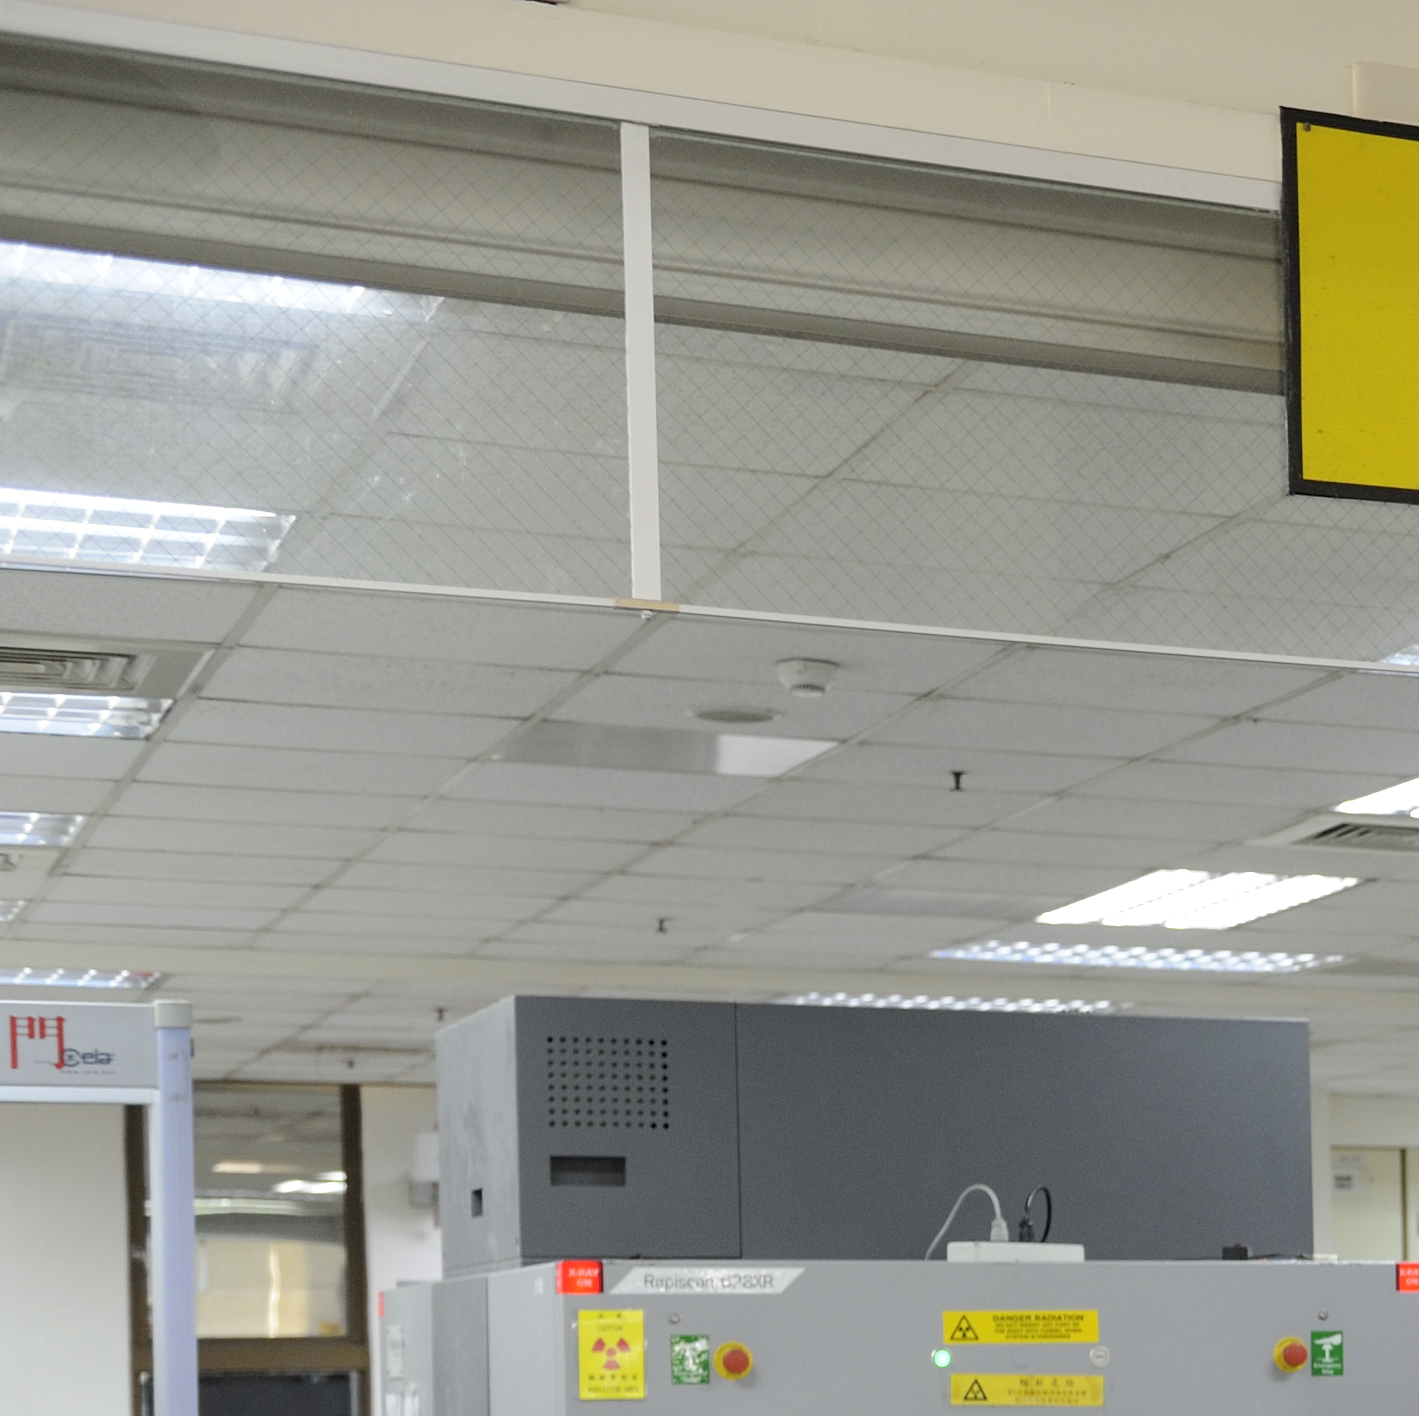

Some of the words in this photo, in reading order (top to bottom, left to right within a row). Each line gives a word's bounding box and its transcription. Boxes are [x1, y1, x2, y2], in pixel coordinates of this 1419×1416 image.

[10, 1016, 65, 1069] 門
[577, 1279, 592, 1288] ON
[643, 1274, 715, 1291] Rapiscan
